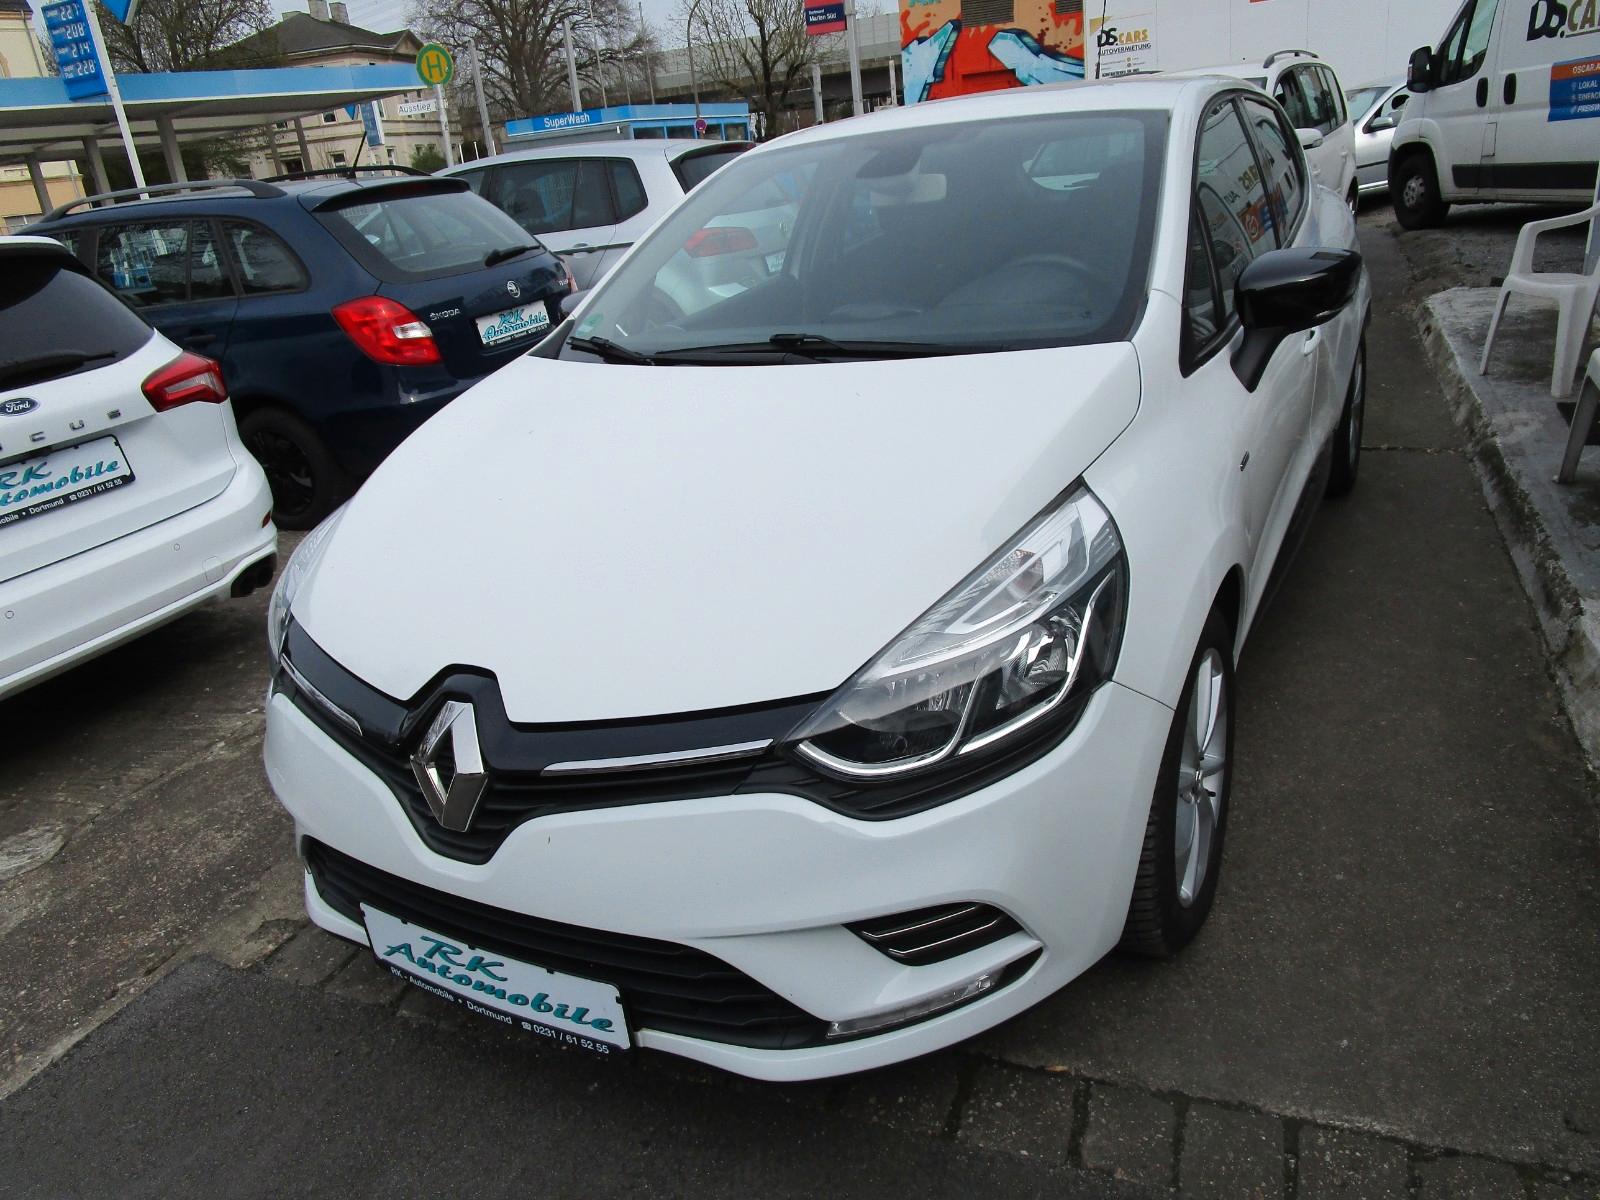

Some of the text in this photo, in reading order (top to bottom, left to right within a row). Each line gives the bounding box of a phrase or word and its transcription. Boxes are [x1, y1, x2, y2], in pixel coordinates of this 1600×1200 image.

[425, 54, 444, 79] H
[399, 102, 432, 114] Ausstieg
[543, 113, 590, 128] SuperWash
[482, 312, 548, 341] Automobile
[5, 400, 31, 413] Ford
[0, 514, 19, 525] obile
[29, 499, 64, 515] Dortmund
[76, 489, 93, 498] 0231
[105, 480, 114, 489] 52
[420, 936, 508, 982] RK
[383, 942, 615, 1033] Automobile
[409, 975, 455, 1002] Automobile
[466, 1000, 513, 1025] Dortmund
[533, 1025, 557, 1039] 0231
[565, 1034, 578, 1045] 61
[580, 1039, 594, 1051] 52
[596, 1043, 610, 1054] 55
